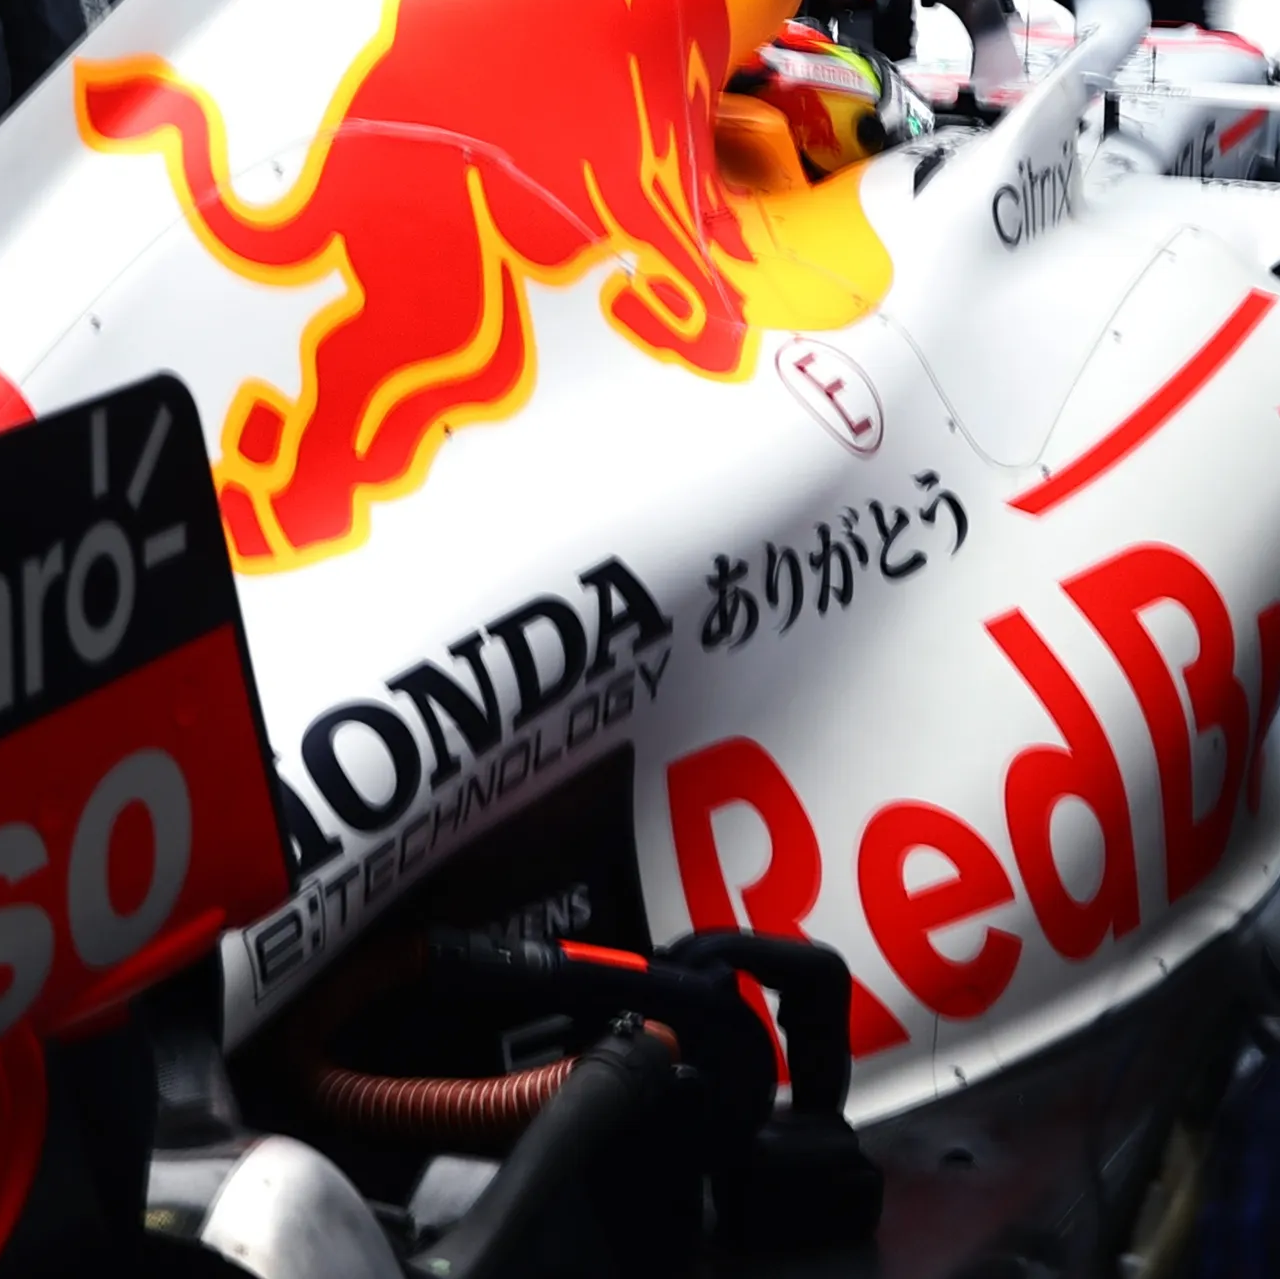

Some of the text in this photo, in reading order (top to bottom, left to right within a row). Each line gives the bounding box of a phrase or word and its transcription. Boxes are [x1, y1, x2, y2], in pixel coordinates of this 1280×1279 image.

[991, 138, 1075, 248] citrix
[793, 350, 874, 437] E
[699, 470, 969, 655] ありがとう
